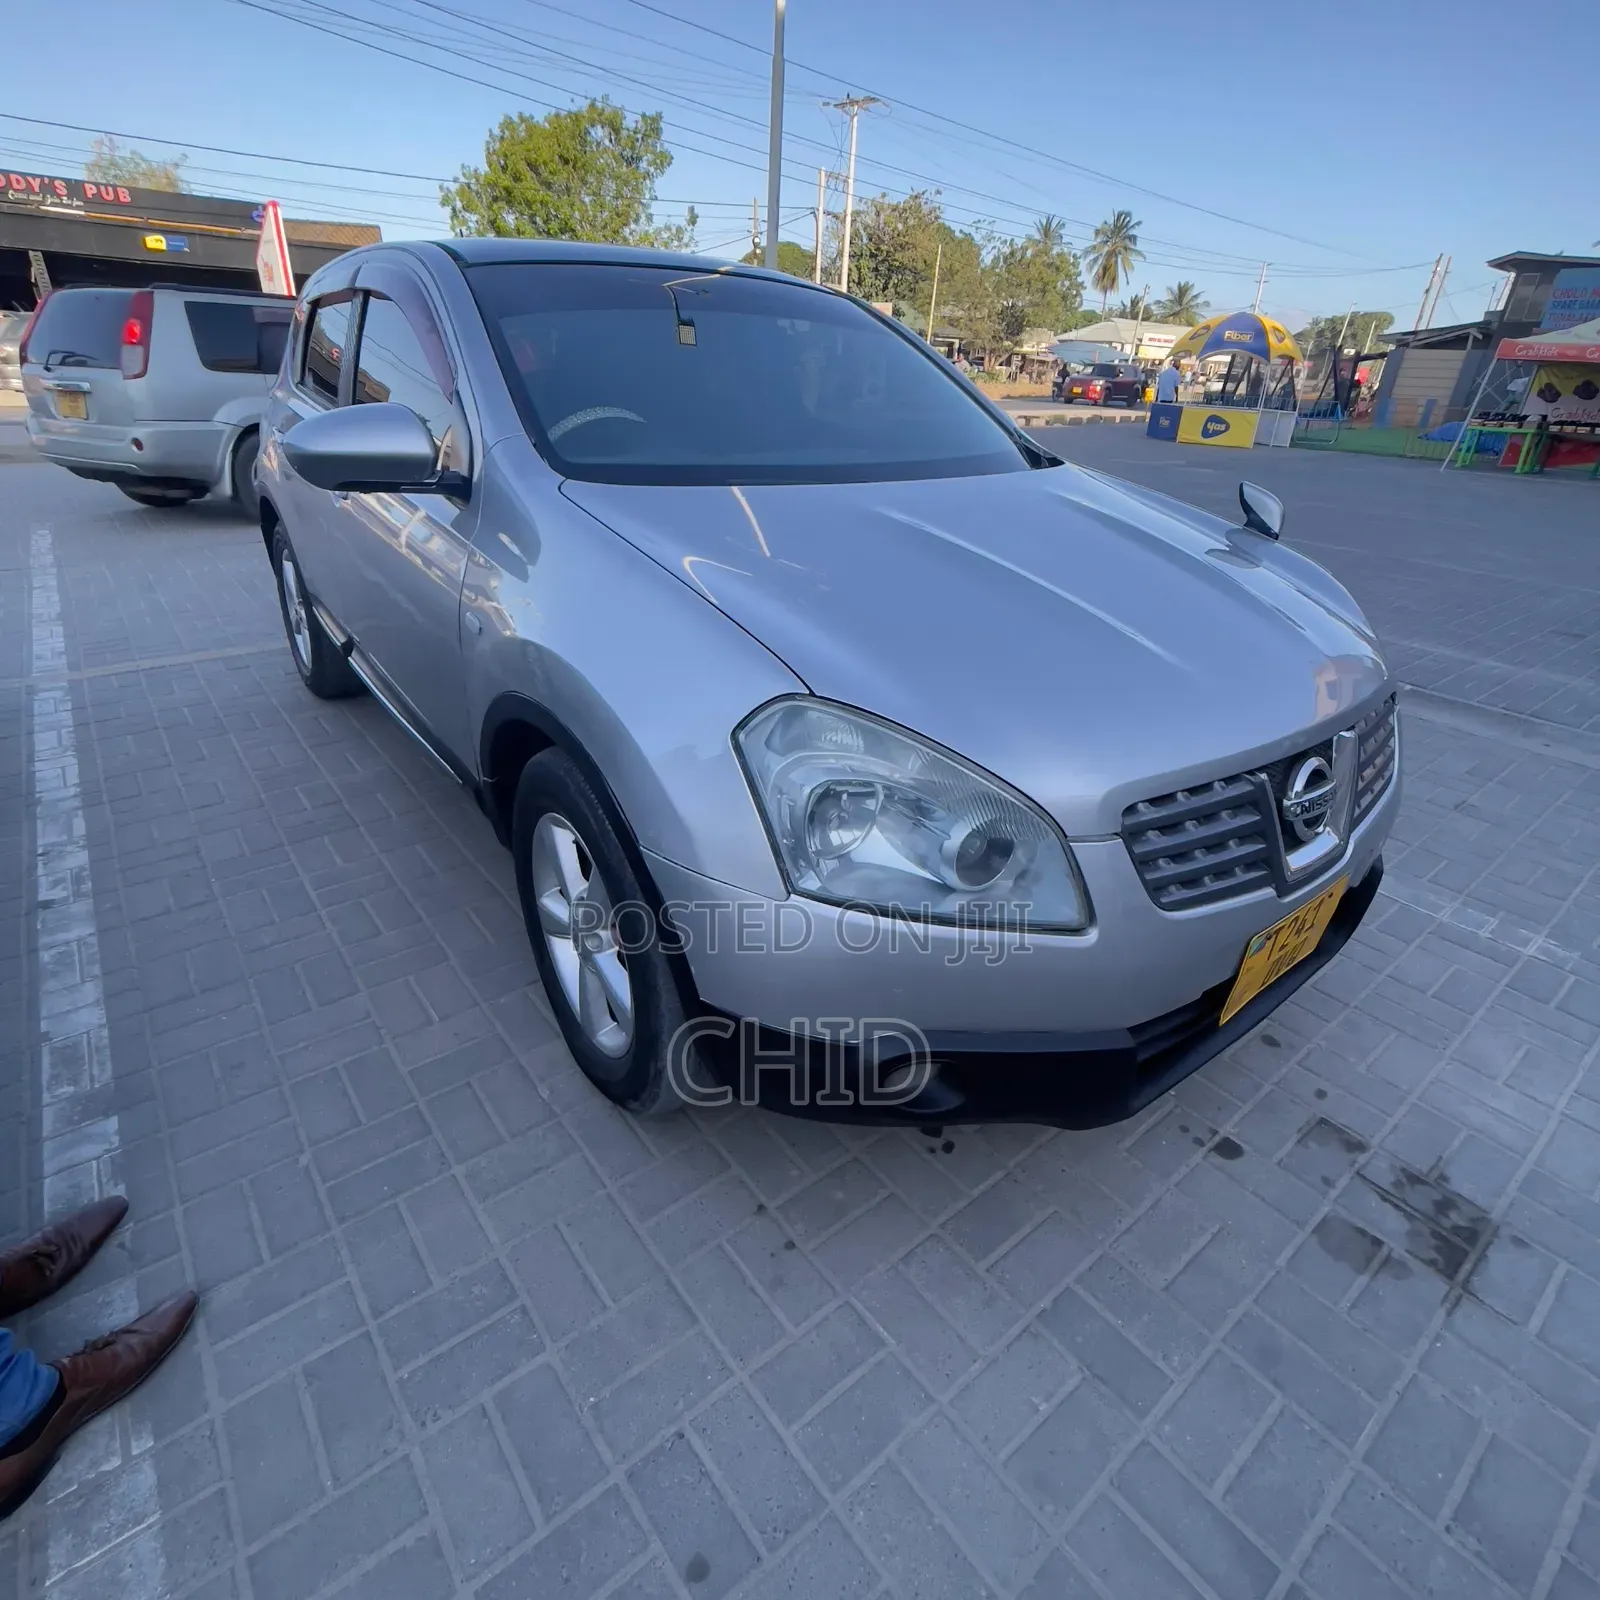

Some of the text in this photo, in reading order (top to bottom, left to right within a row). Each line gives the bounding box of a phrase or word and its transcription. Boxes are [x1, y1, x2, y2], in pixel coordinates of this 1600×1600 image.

[83, 182, 132, 203] PUB
[1224, 331, 1253, 341] Fiber
[1206, 422, 1226, 433] yas
